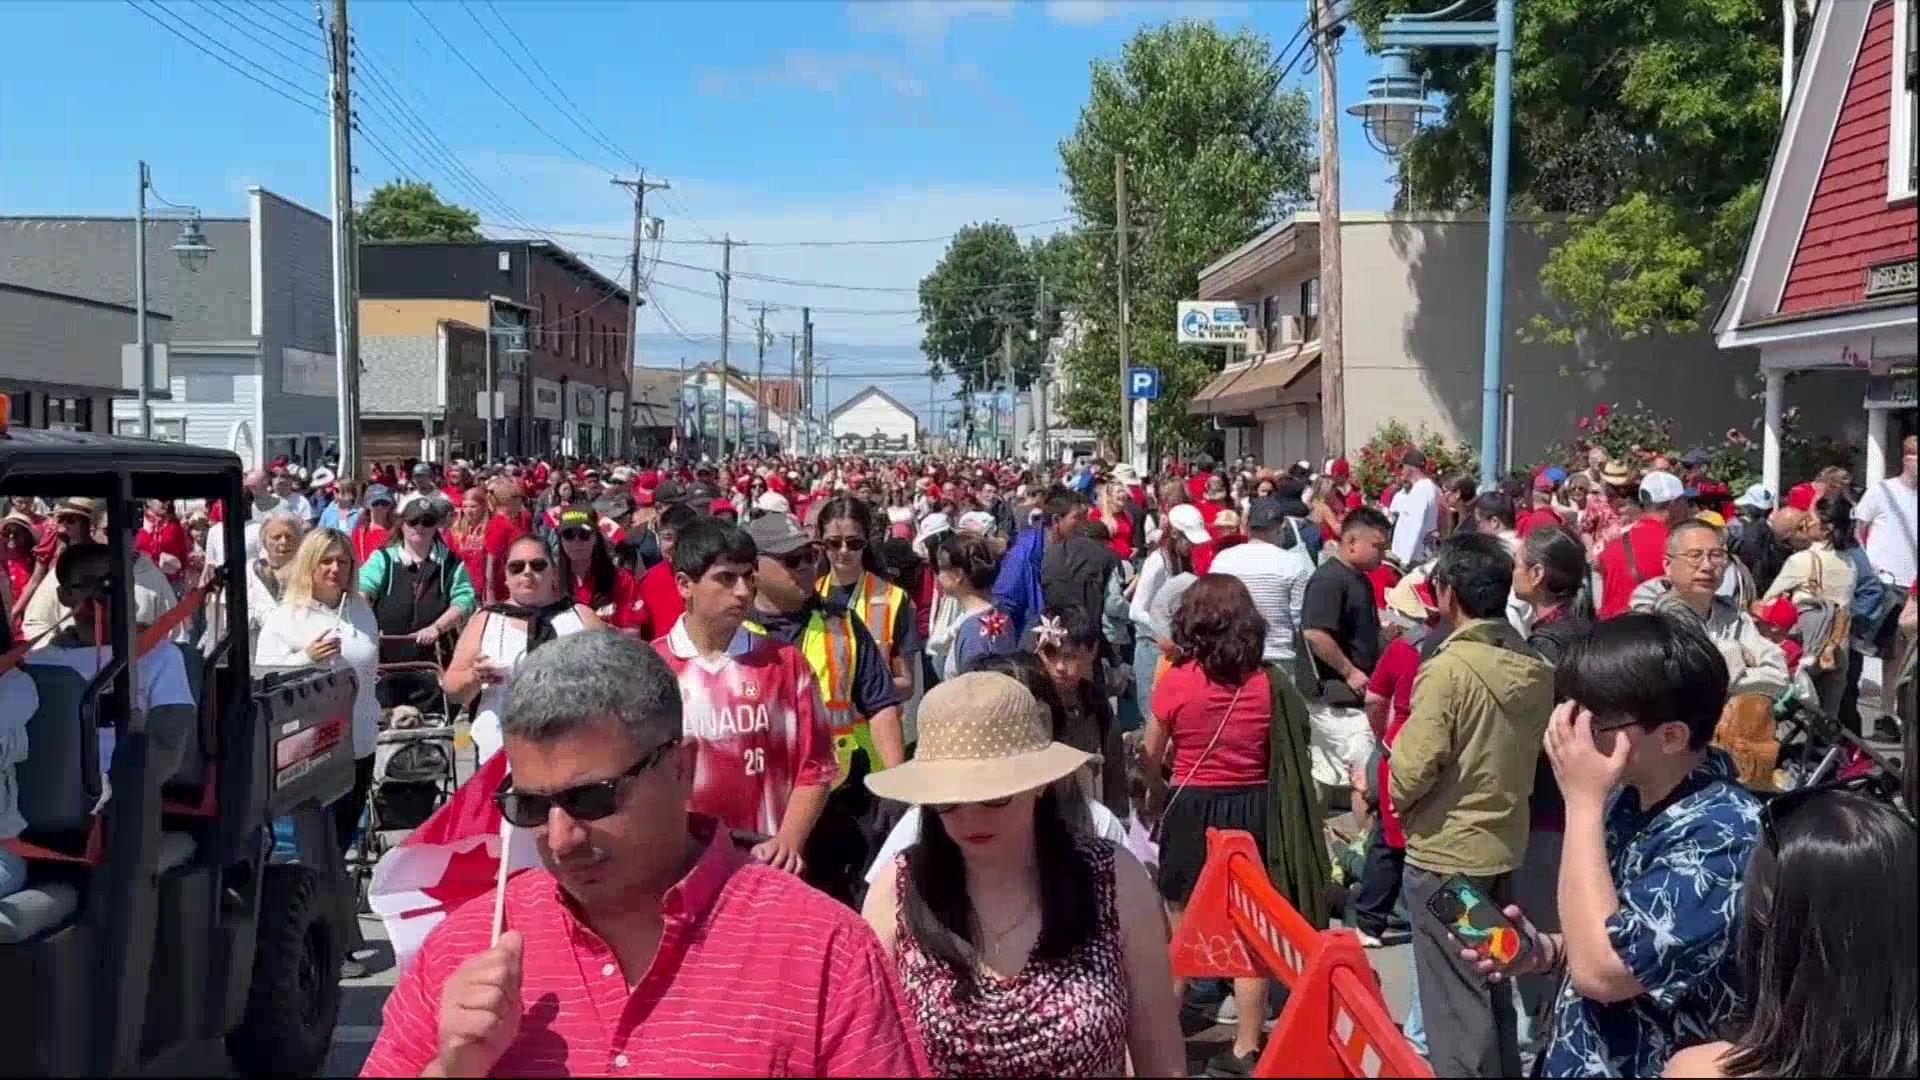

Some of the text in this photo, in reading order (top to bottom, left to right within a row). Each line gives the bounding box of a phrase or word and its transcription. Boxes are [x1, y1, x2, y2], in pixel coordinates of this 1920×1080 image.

[1133, 373, 1152, 394] P
[683, 703, 770, 739] ANADA
[743, 747, 765, 776] 26
